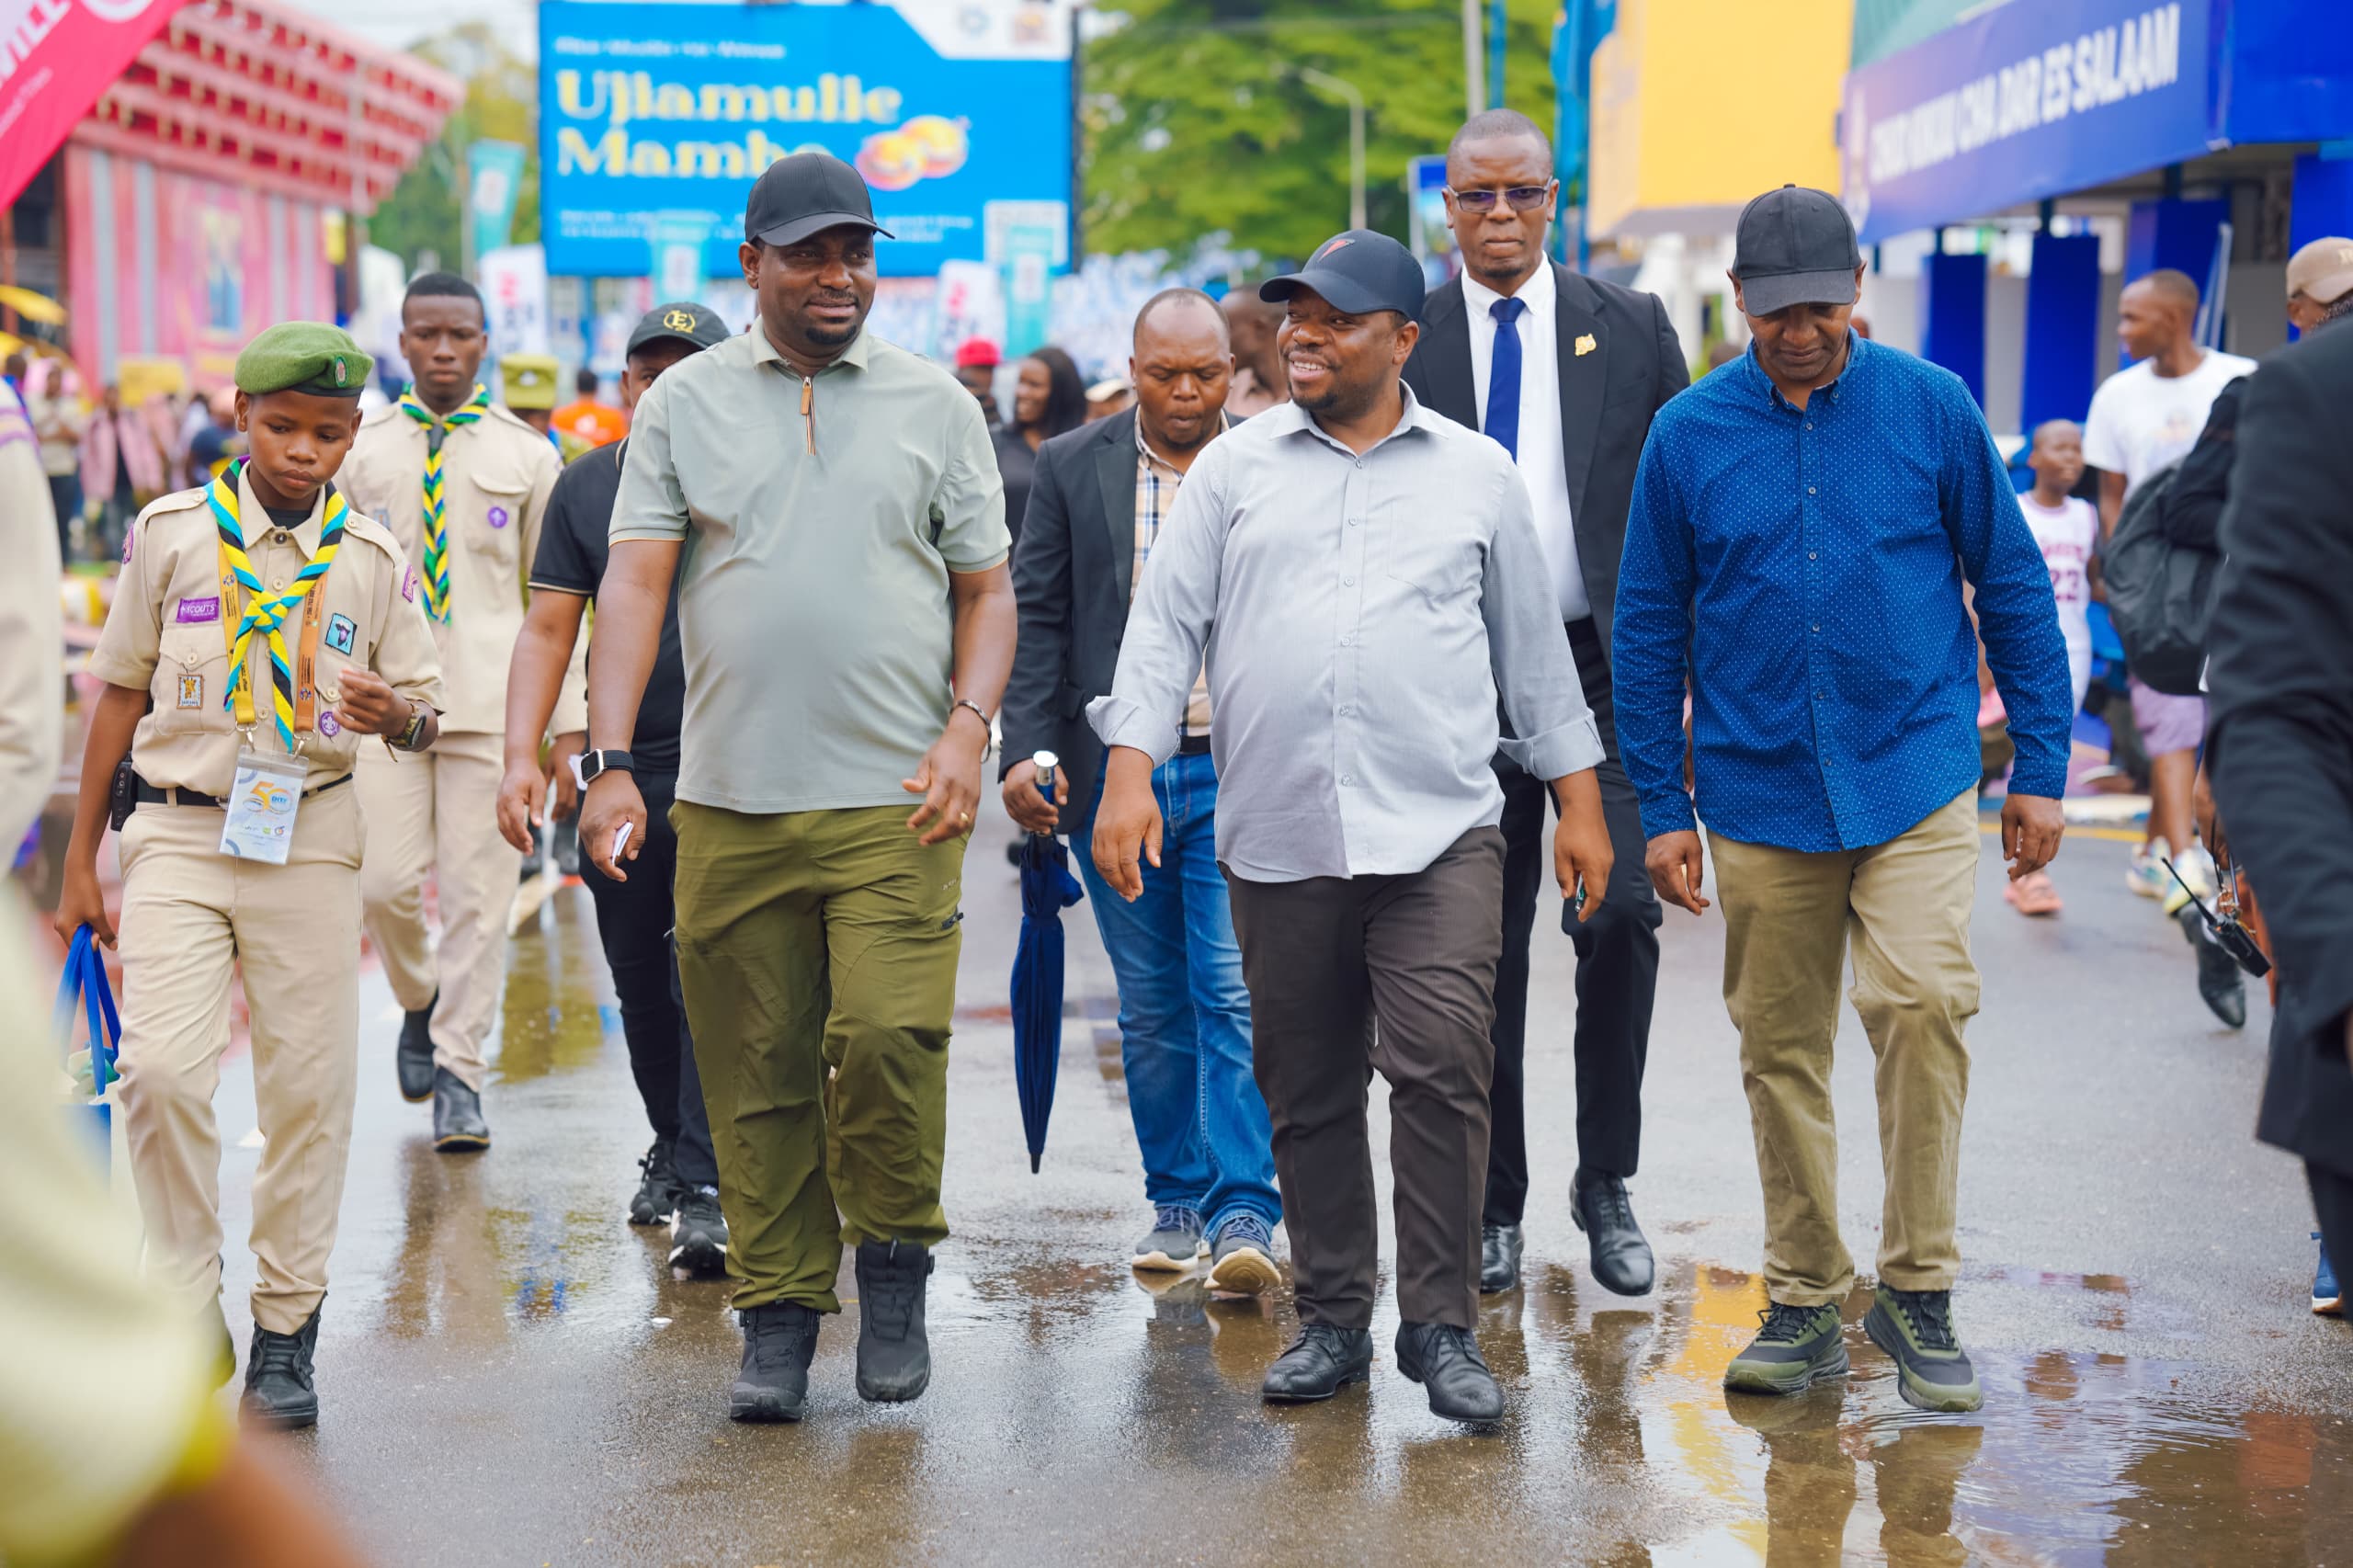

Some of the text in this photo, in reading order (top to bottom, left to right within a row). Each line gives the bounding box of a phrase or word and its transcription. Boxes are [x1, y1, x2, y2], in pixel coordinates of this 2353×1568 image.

[1998, 57, 2040, 139] DAR
[2040, 42, 2072, 124] ES
[2073, 2, 2180, 112] SALAAM
[556, 127, 832, 178] Mamb
